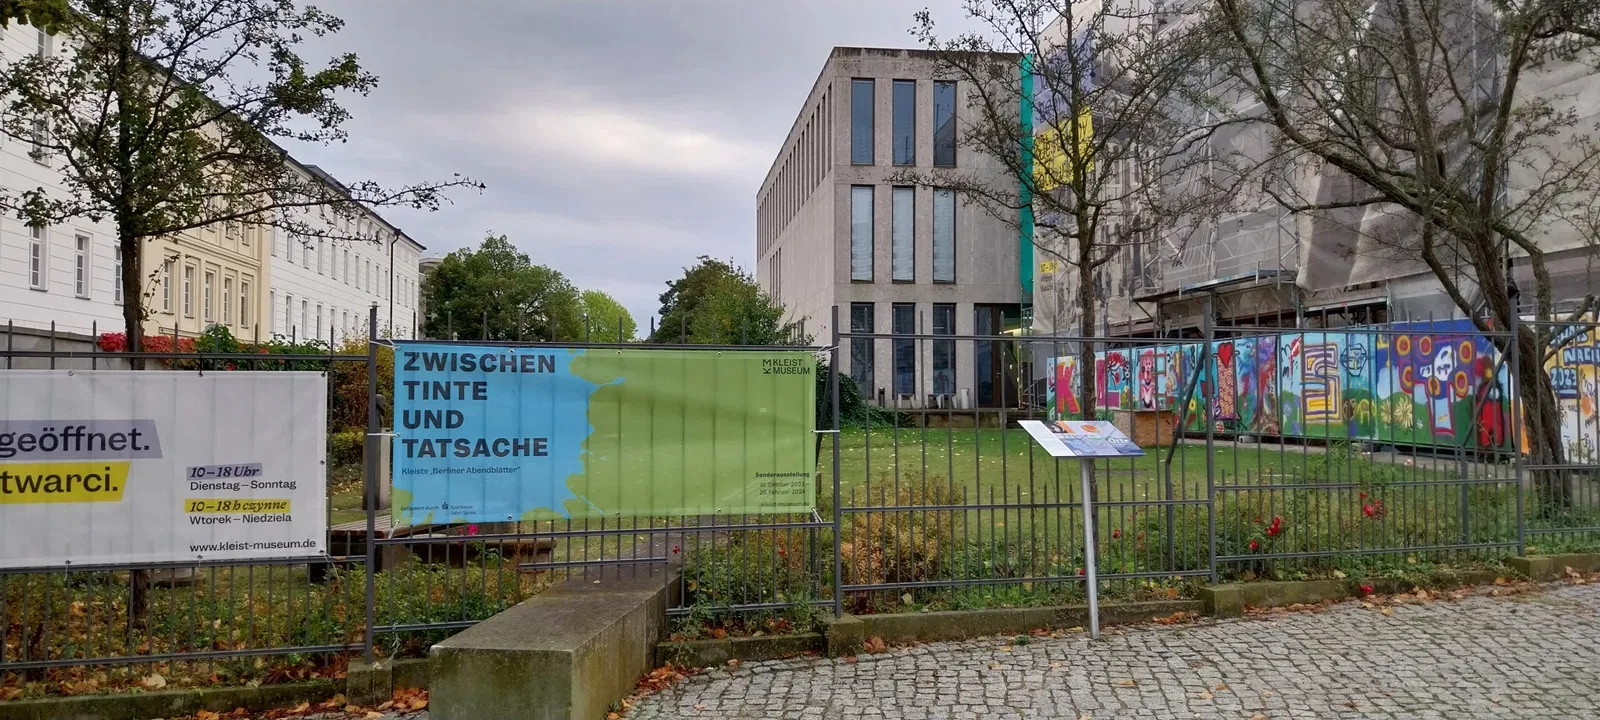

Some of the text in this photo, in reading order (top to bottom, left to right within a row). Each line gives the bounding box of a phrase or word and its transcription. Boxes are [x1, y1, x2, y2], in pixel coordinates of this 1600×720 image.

[403, 352, 555, 373] ZWISCHEN
[403, 381, 488, 400] TINTE
[402, 409, 464, 430] UND
[0, 425, 149, 458] geöffnet.
[402, 438, 548, 458] TATSACHE
[234, 465, 260, 477] Uhr
[401, 467, 428, 475] Kleists
[242, 500, 287, 513] czynne
[190, 539, 316, 552] www.kleist-museum.de
